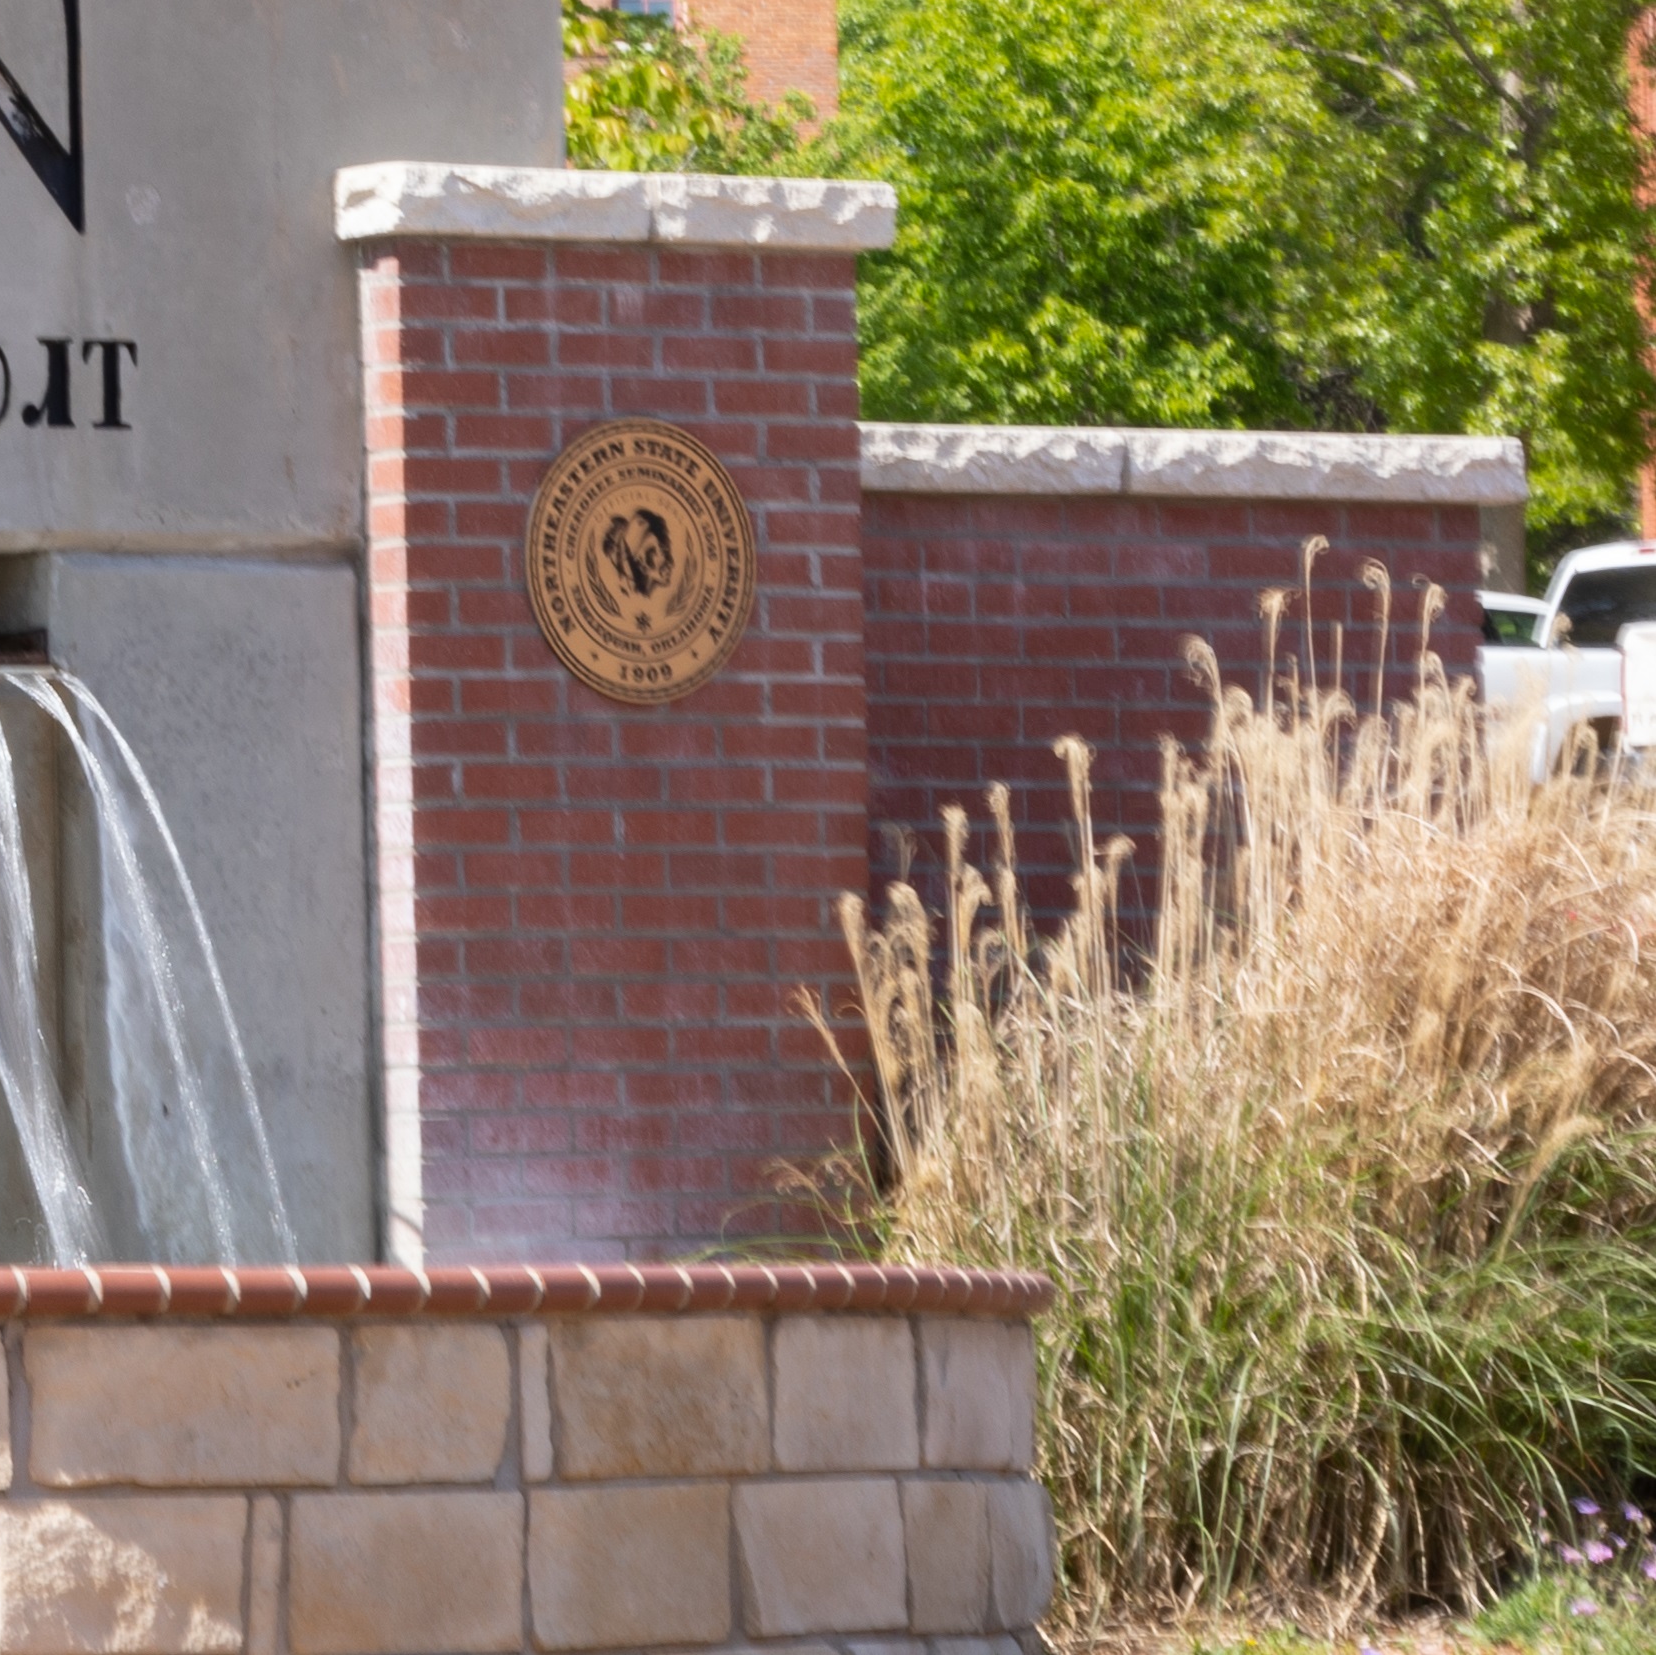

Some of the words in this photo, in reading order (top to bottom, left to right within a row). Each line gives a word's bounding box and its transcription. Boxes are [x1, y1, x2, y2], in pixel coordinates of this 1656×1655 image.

[542, 441, 625, 636] NORTHEASTERN
[632, 439, 703, 480] STATE
[702, 478, 740, 645] UNIVERSITY
[618, 663, 674, 684] 1909
